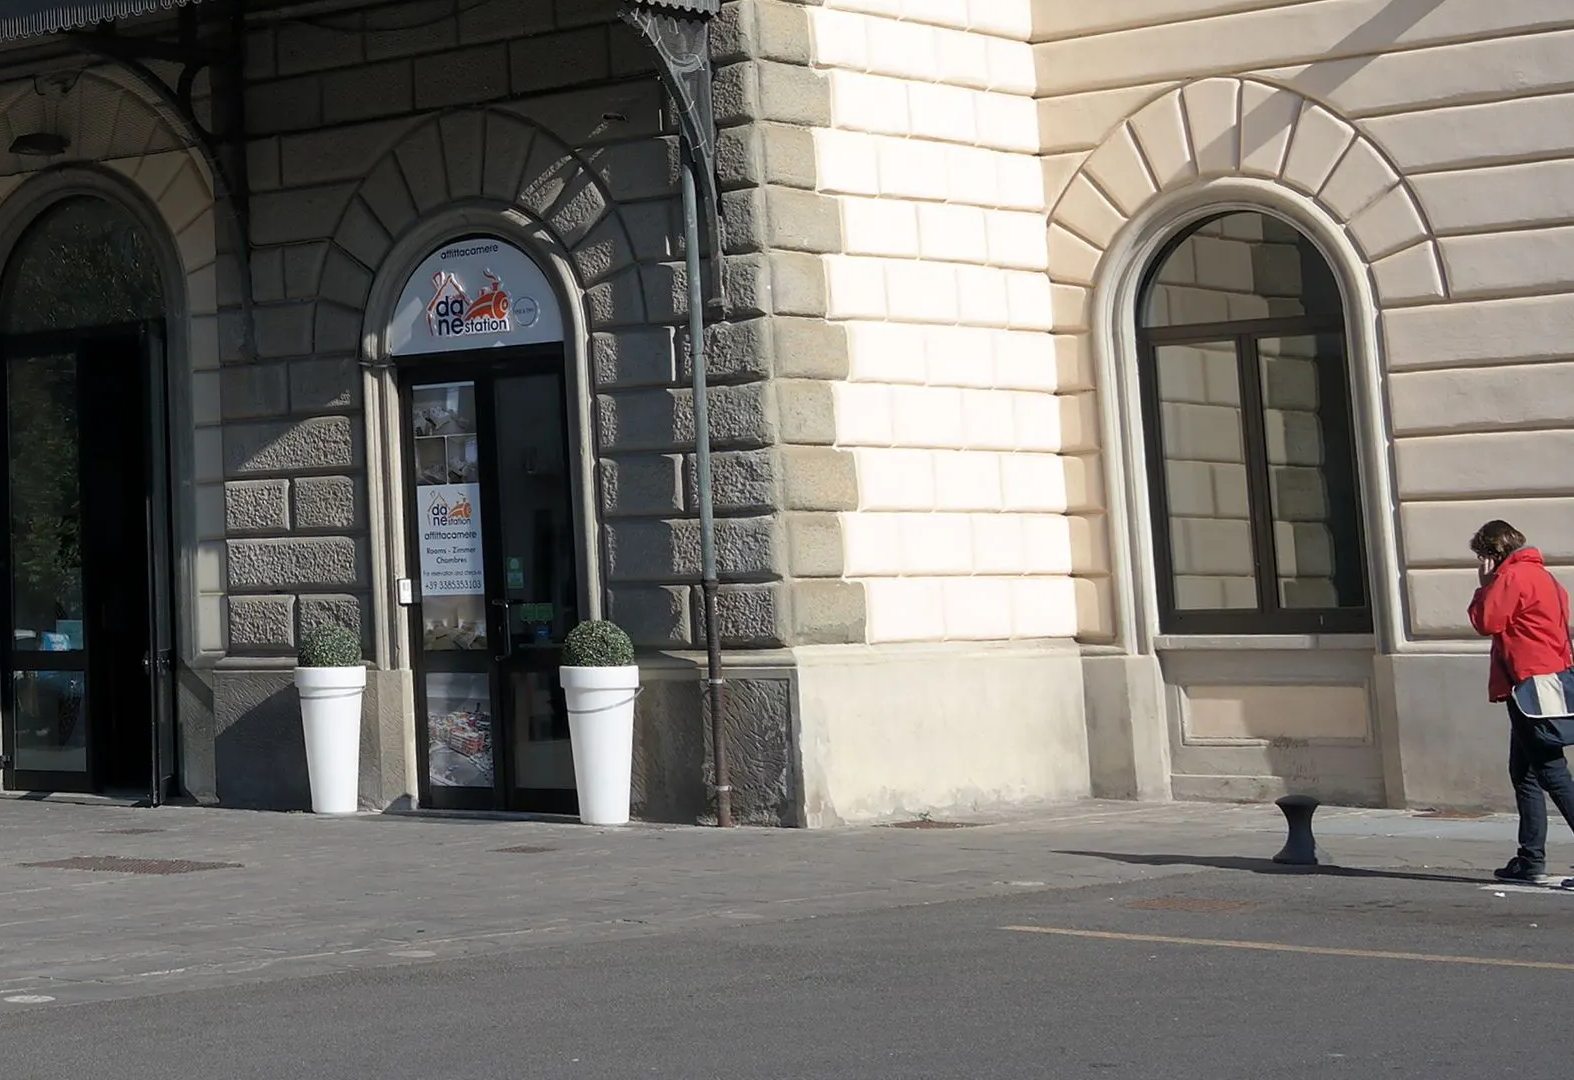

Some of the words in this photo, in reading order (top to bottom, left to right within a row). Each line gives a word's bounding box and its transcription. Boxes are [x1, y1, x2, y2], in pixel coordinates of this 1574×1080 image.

[440, 244, 499, 260] affittacamere
[436, 296, 464, 318] da
[425, 531, 476, 540] affittacamere
[452, 546, 476, 554] Zimmer
